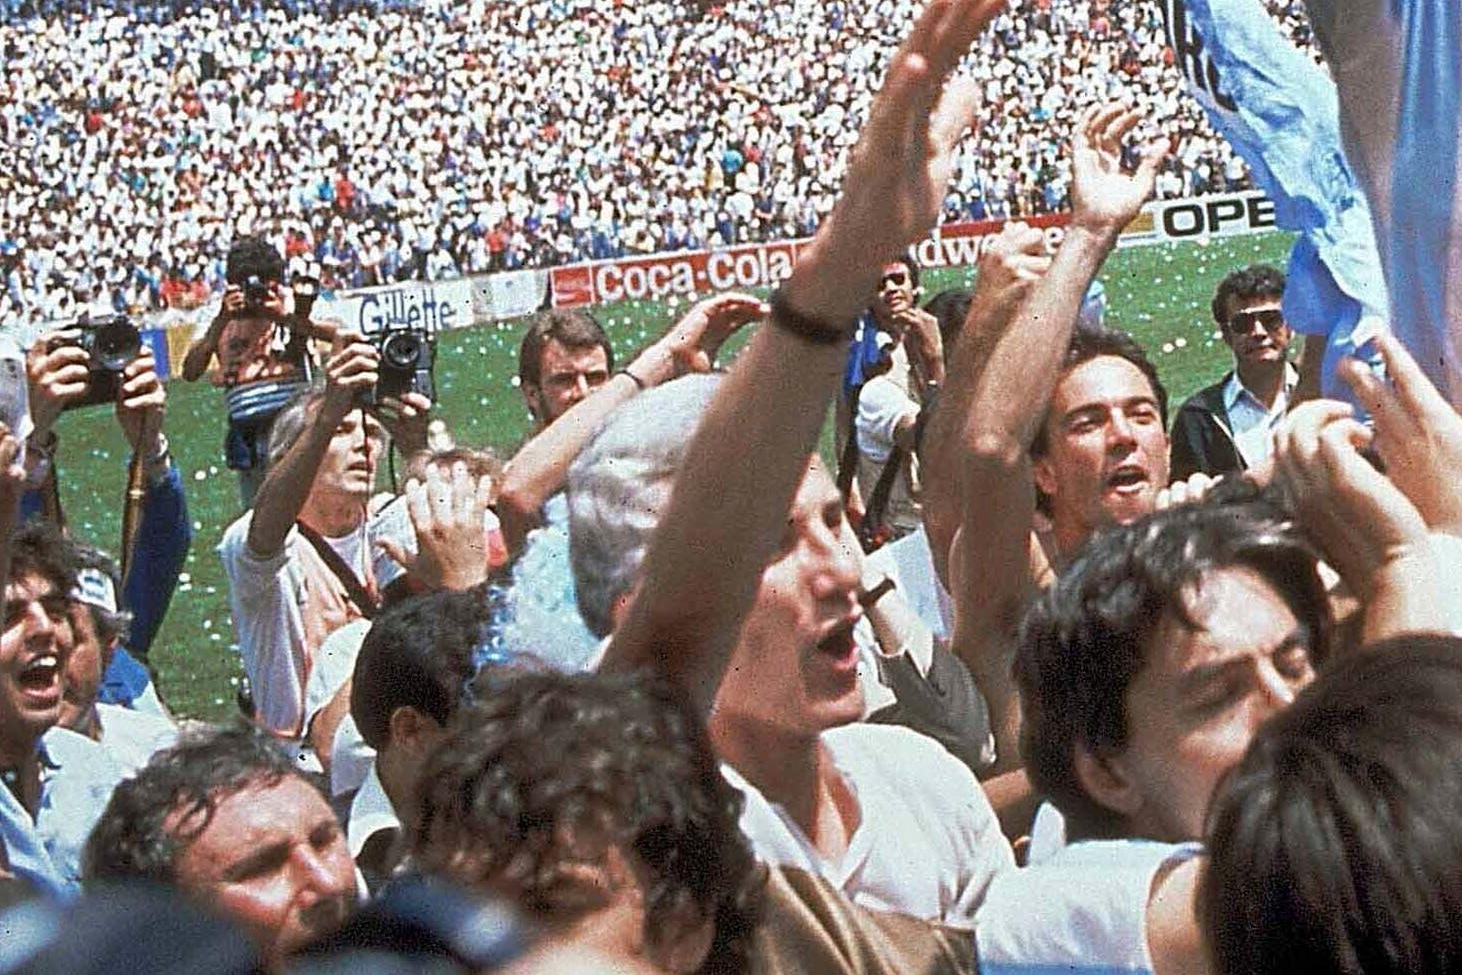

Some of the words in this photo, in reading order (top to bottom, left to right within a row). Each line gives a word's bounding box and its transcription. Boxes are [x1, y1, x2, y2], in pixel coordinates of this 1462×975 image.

[1163, 197, 1275, 237] OPE
[597, 248, 793, 301] Coca-Cola
[359, 287, 457, 336] Gillette
